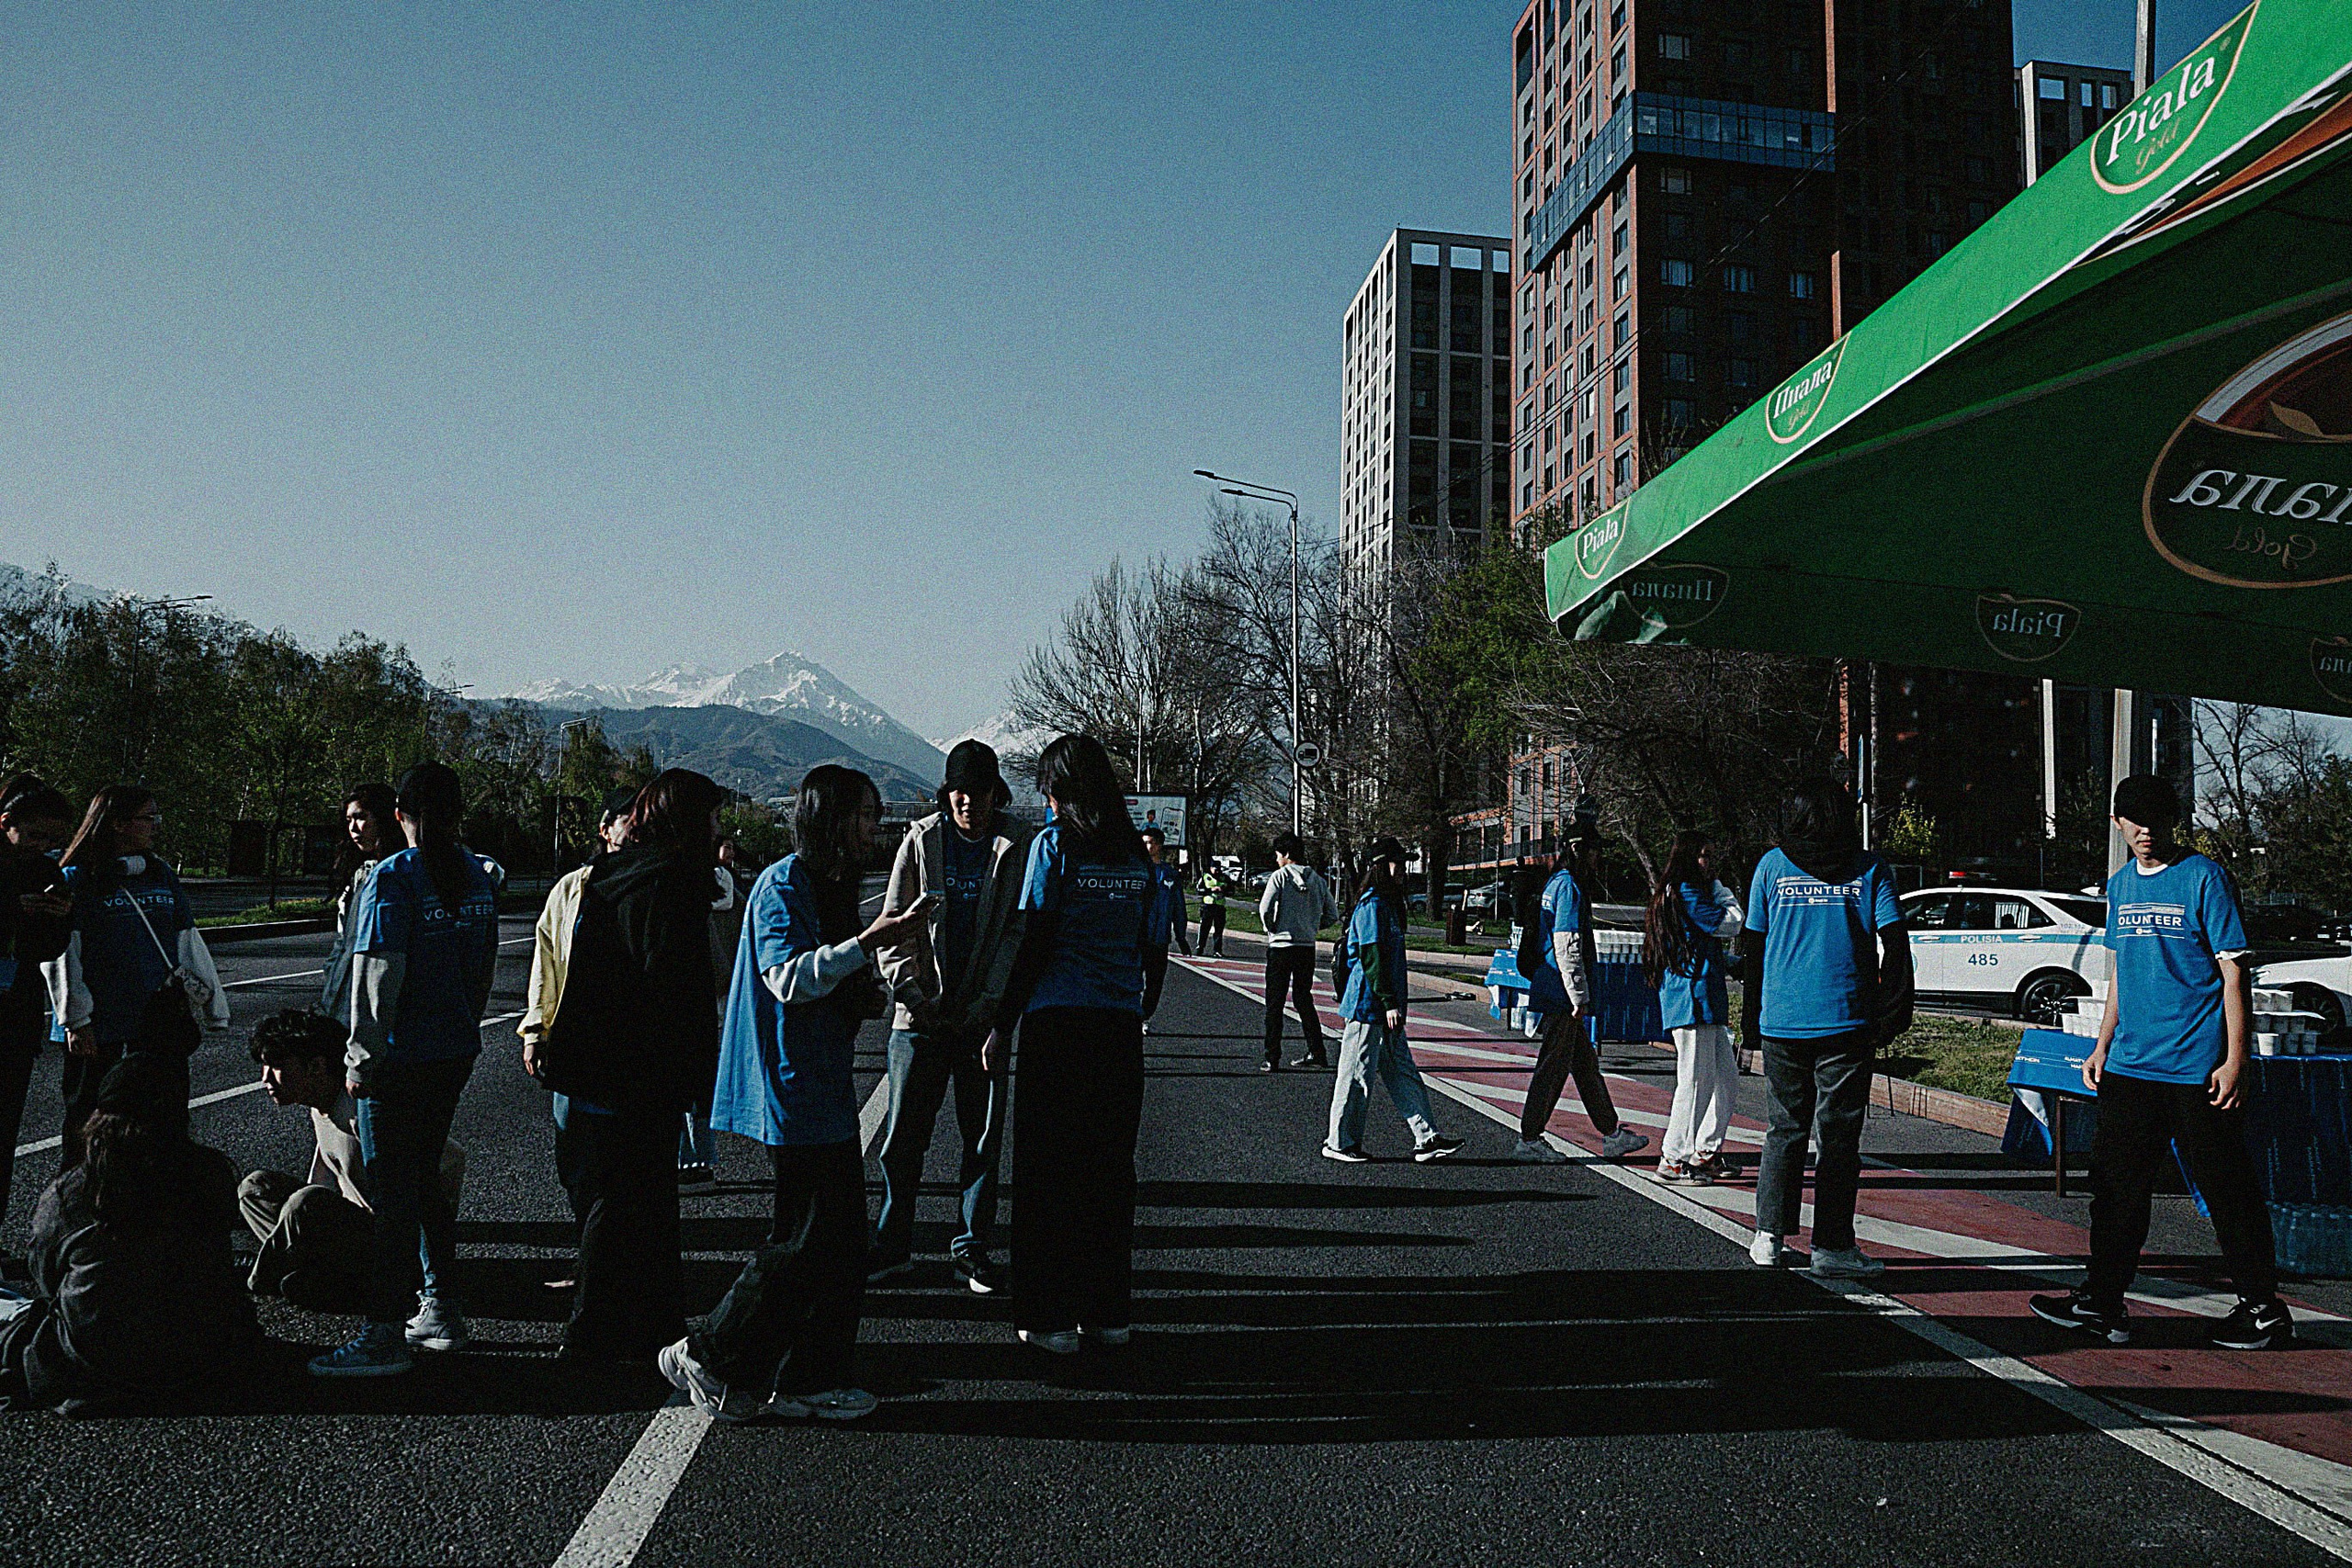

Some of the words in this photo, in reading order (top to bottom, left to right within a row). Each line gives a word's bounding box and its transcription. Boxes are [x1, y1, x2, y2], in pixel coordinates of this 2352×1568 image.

[2106, 56, 2216, 166] Piala
[1773, 361, 1832, 420] Пиала
[1582, 519, 1618, 559] Piala
[104, 895, 175, 908] VOLNTEER
[2118, 915, 2182, 927] OLUNTEER
[1960, 935, 2003, 943] POLISIA
[1968, 953, 1998, 966] 485
